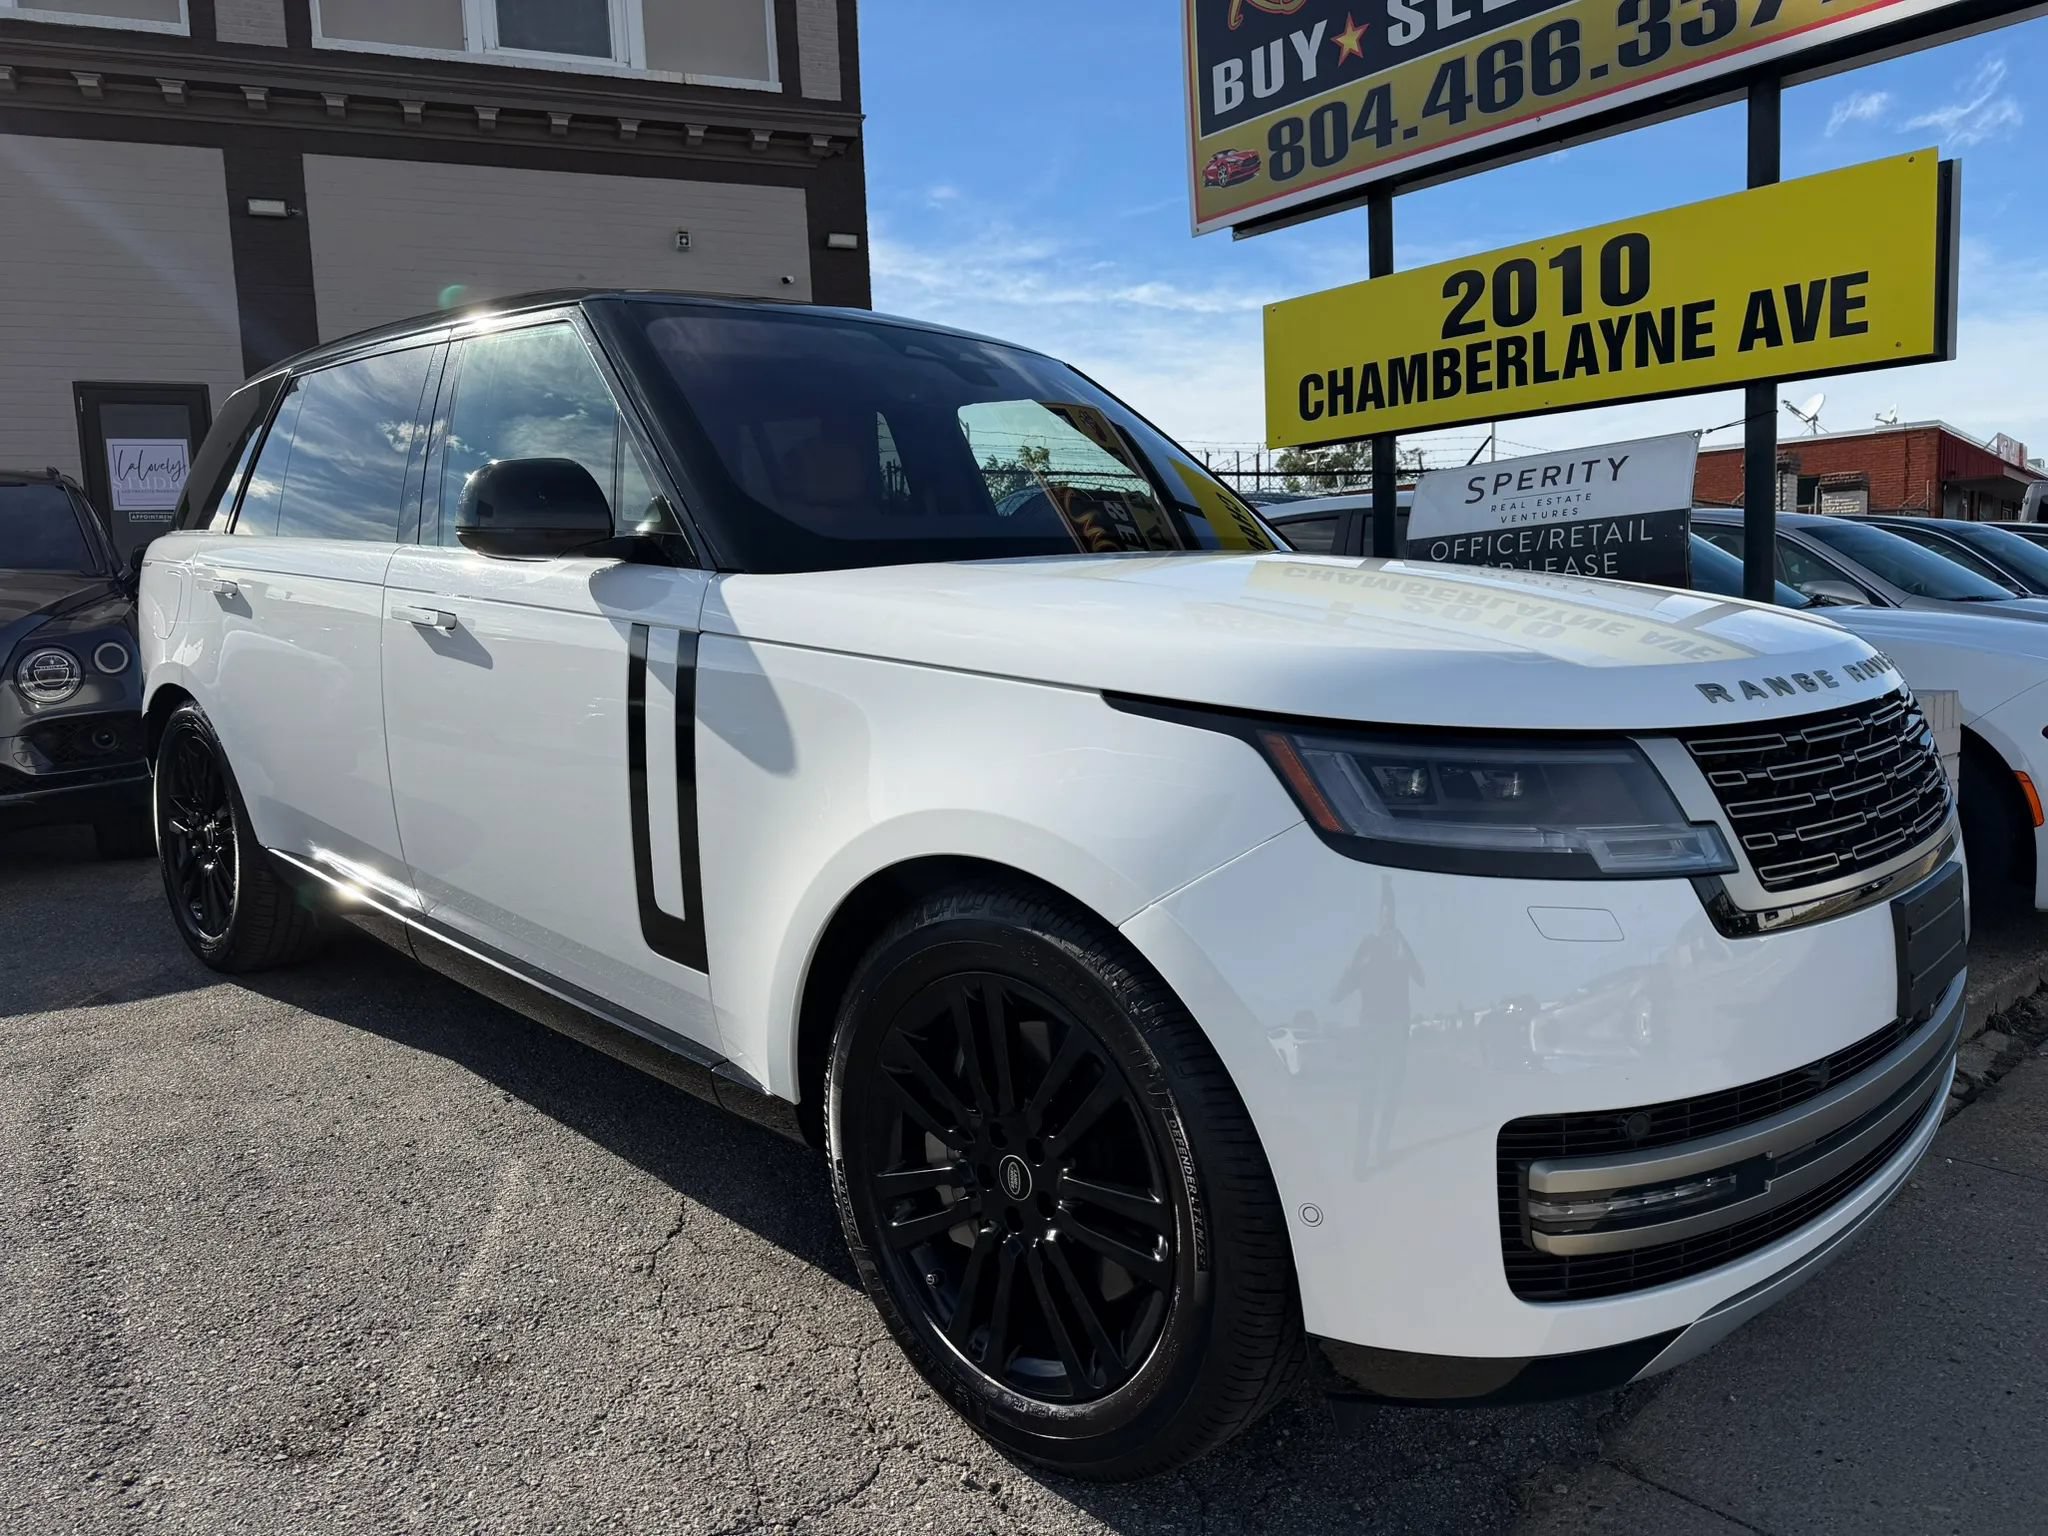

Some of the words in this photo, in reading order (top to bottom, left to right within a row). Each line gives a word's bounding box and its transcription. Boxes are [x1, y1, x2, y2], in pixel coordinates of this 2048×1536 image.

[1212, 19, 1328, 116] BUY
[1267, 0, 1832, 183] 804.466.33
[1441, 232, 1651, 340] 2010
[1298, 299, 1716, 422] CHAMBERLAYNE
[1737, 271, 1870, 353] AVE
[1464, 455, 1629, 505] SPERITY
[1490, 501, 1526, 513] REAL
[1536, 492, 1592, 507] ESTATE
[1430, 519, 1653, 562] OFFICE/RETAIL
[1500, 507, 1579, 524] VENTURES
[1695, 670, 1840, 704] RANGE
[1168, 1118, 1198, 1195] DEFENDER
